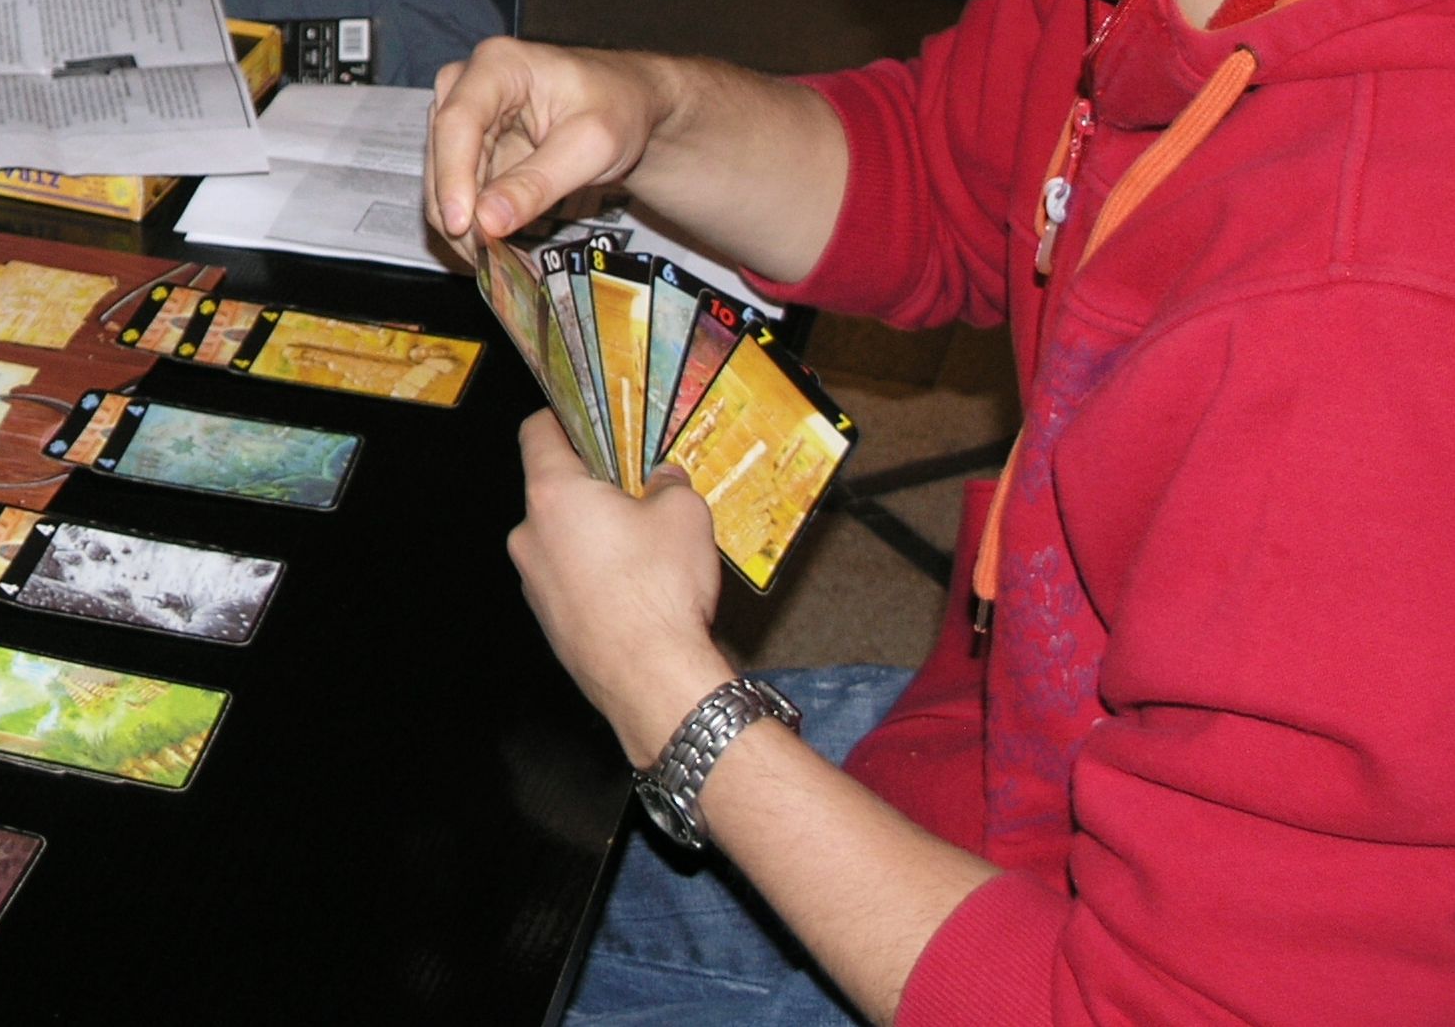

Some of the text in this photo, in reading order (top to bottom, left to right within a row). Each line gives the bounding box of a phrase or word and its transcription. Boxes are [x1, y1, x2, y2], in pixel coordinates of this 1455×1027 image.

[544, 250, 561, 272] 10
[571, 252, 581, 273] 7
[593, 250, 606, 270] 8
[711, 299, 736, 327] 10
[757, 326, 774, 345] 7
[836, 413, 852, 430] 7
